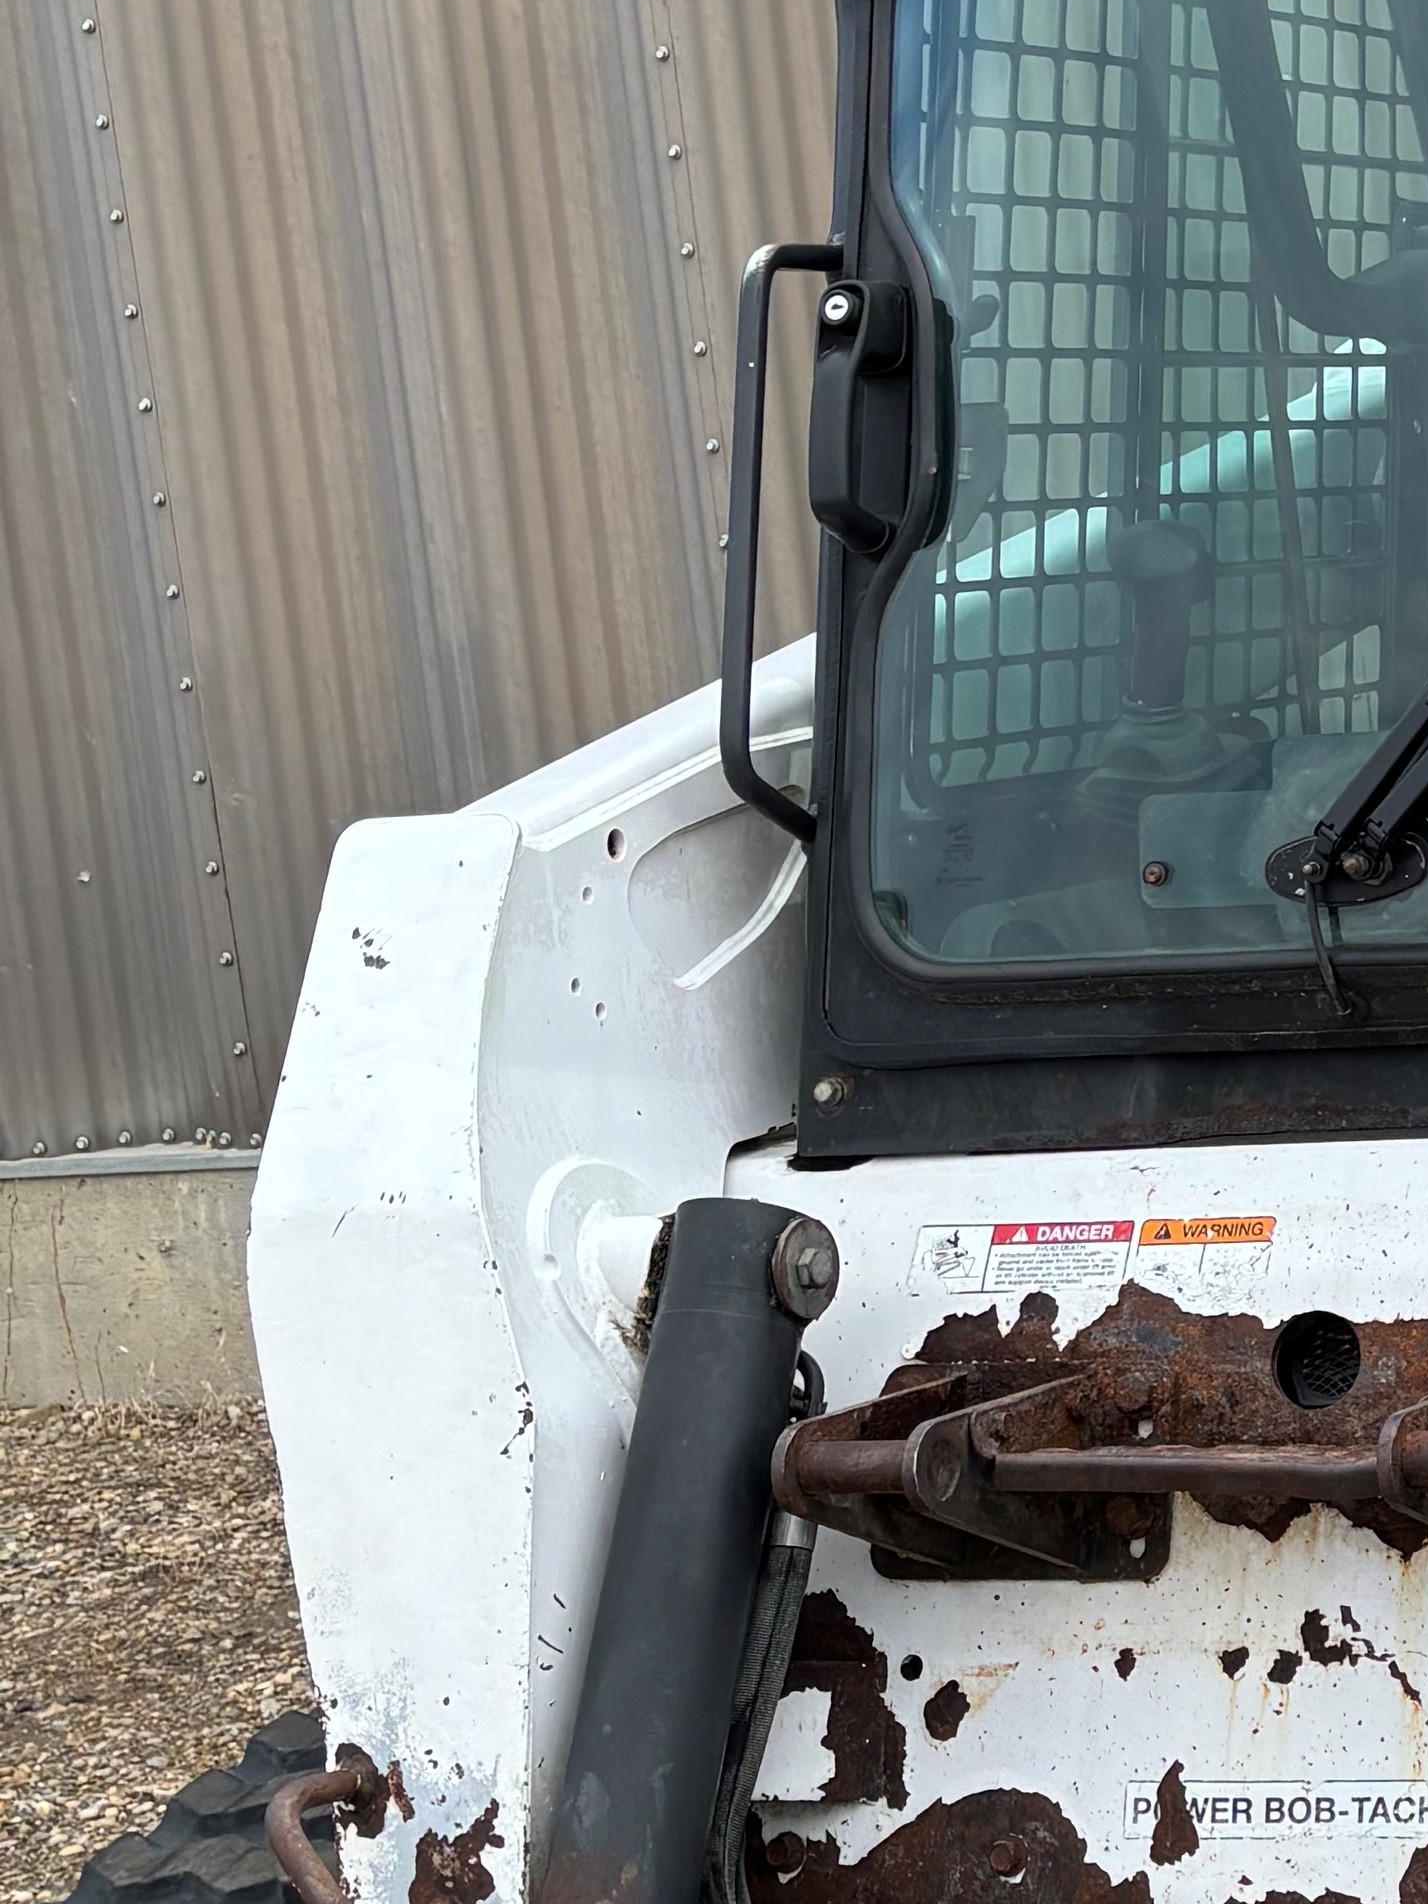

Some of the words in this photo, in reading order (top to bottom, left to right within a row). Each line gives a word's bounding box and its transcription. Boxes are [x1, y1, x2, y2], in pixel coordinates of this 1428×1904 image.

[1036, 1223, 1114, 1242] DANGER
[1183, 1222, 1264, 1238] WARNING
[1132, 1796, 1253, 1825] PWER
